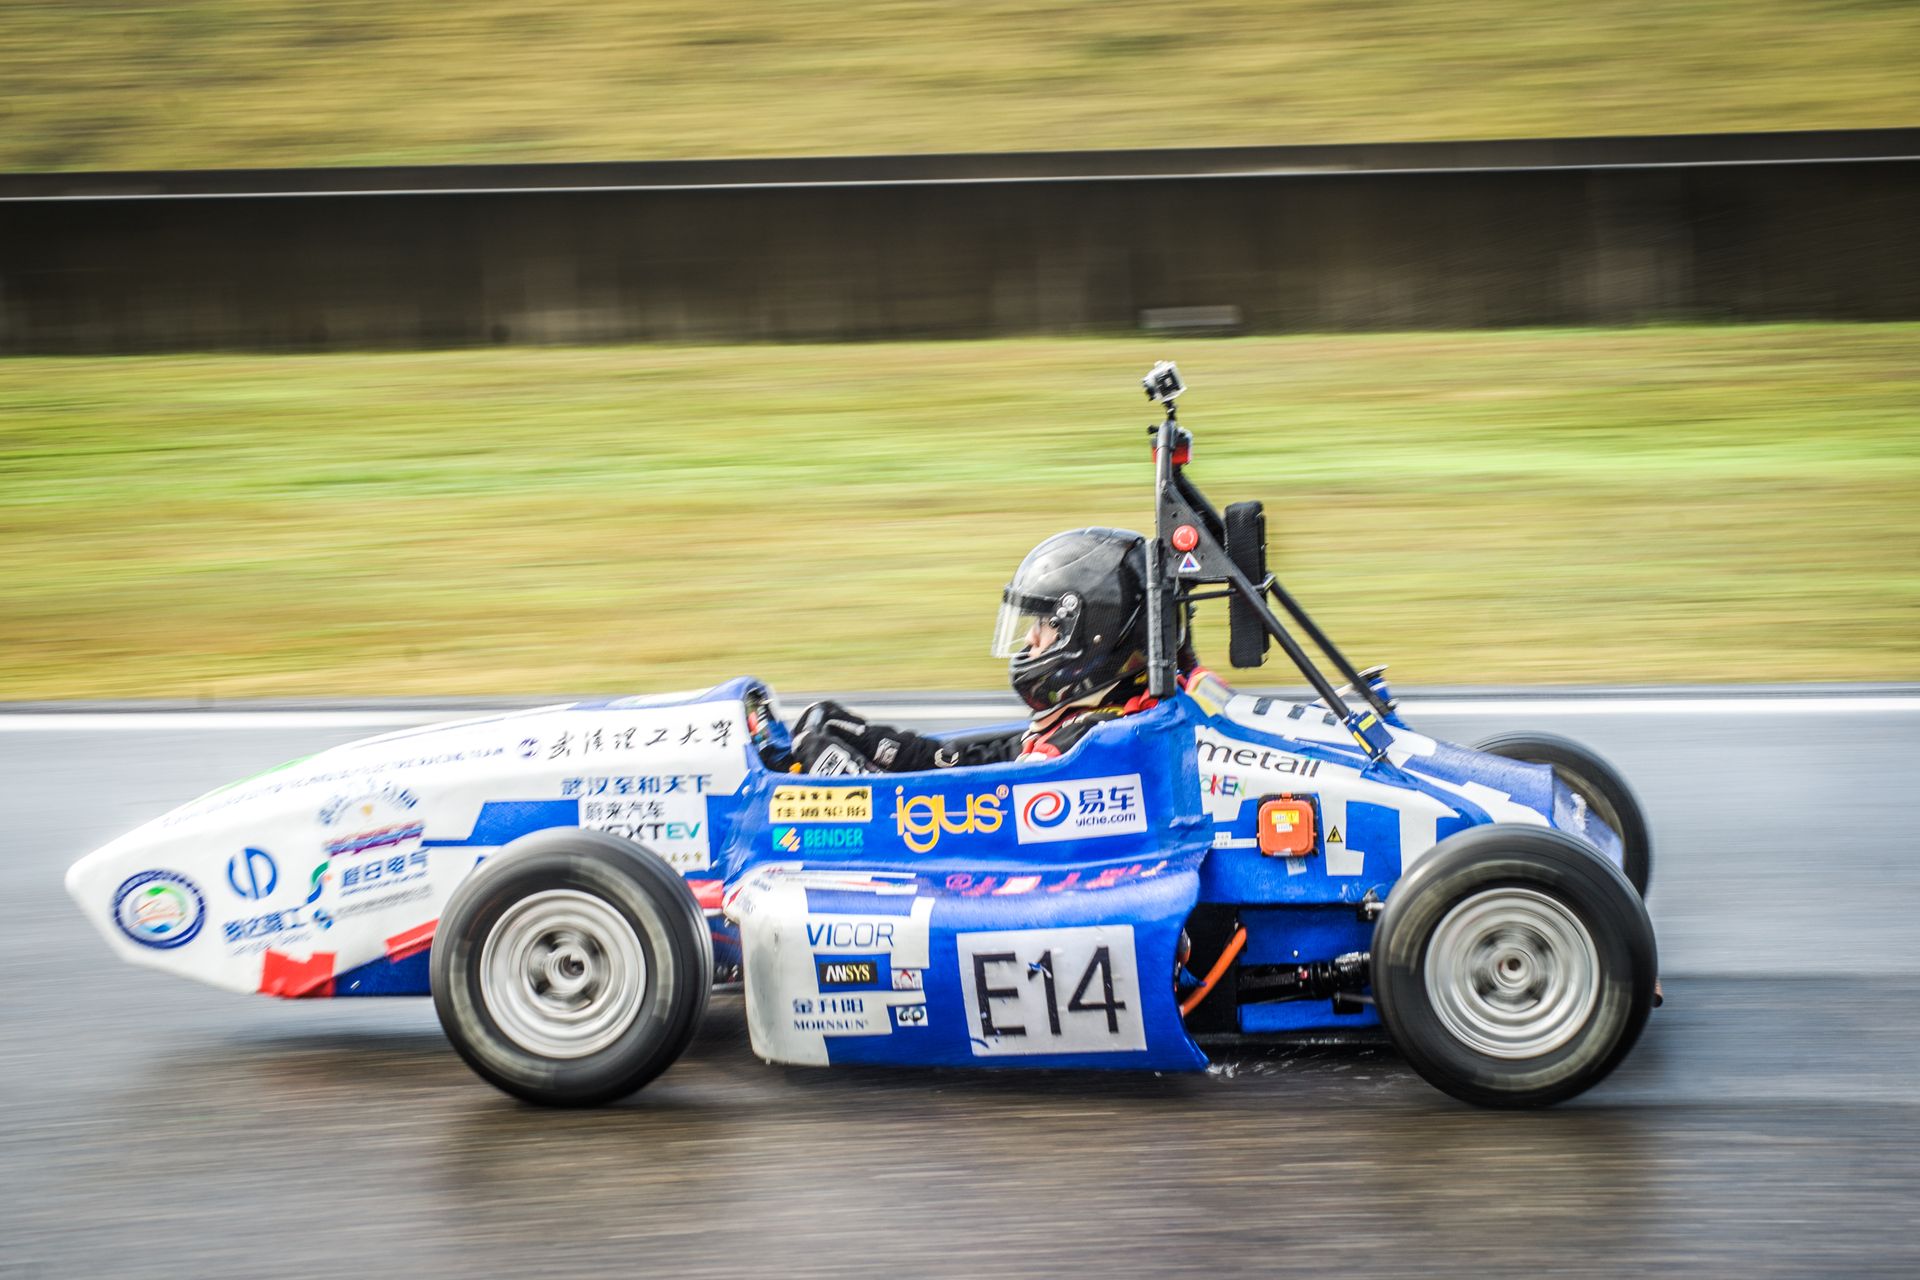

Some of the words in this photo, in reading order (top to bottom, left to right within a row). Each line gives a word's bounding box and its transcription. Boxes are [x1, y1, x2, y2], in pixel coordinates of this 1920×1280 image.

[1197, 739, 1321, 778] metall
[1078, 786, 1135, 814] 易车
[1076, 812, 1136, 827] yiche.com
[804, 828, 864, 849] BENDER
[806, 922, 894, 947] VICOR
[825, 964, 870, 983] ANSYS
[972, 946, 1126, 1037] E14
